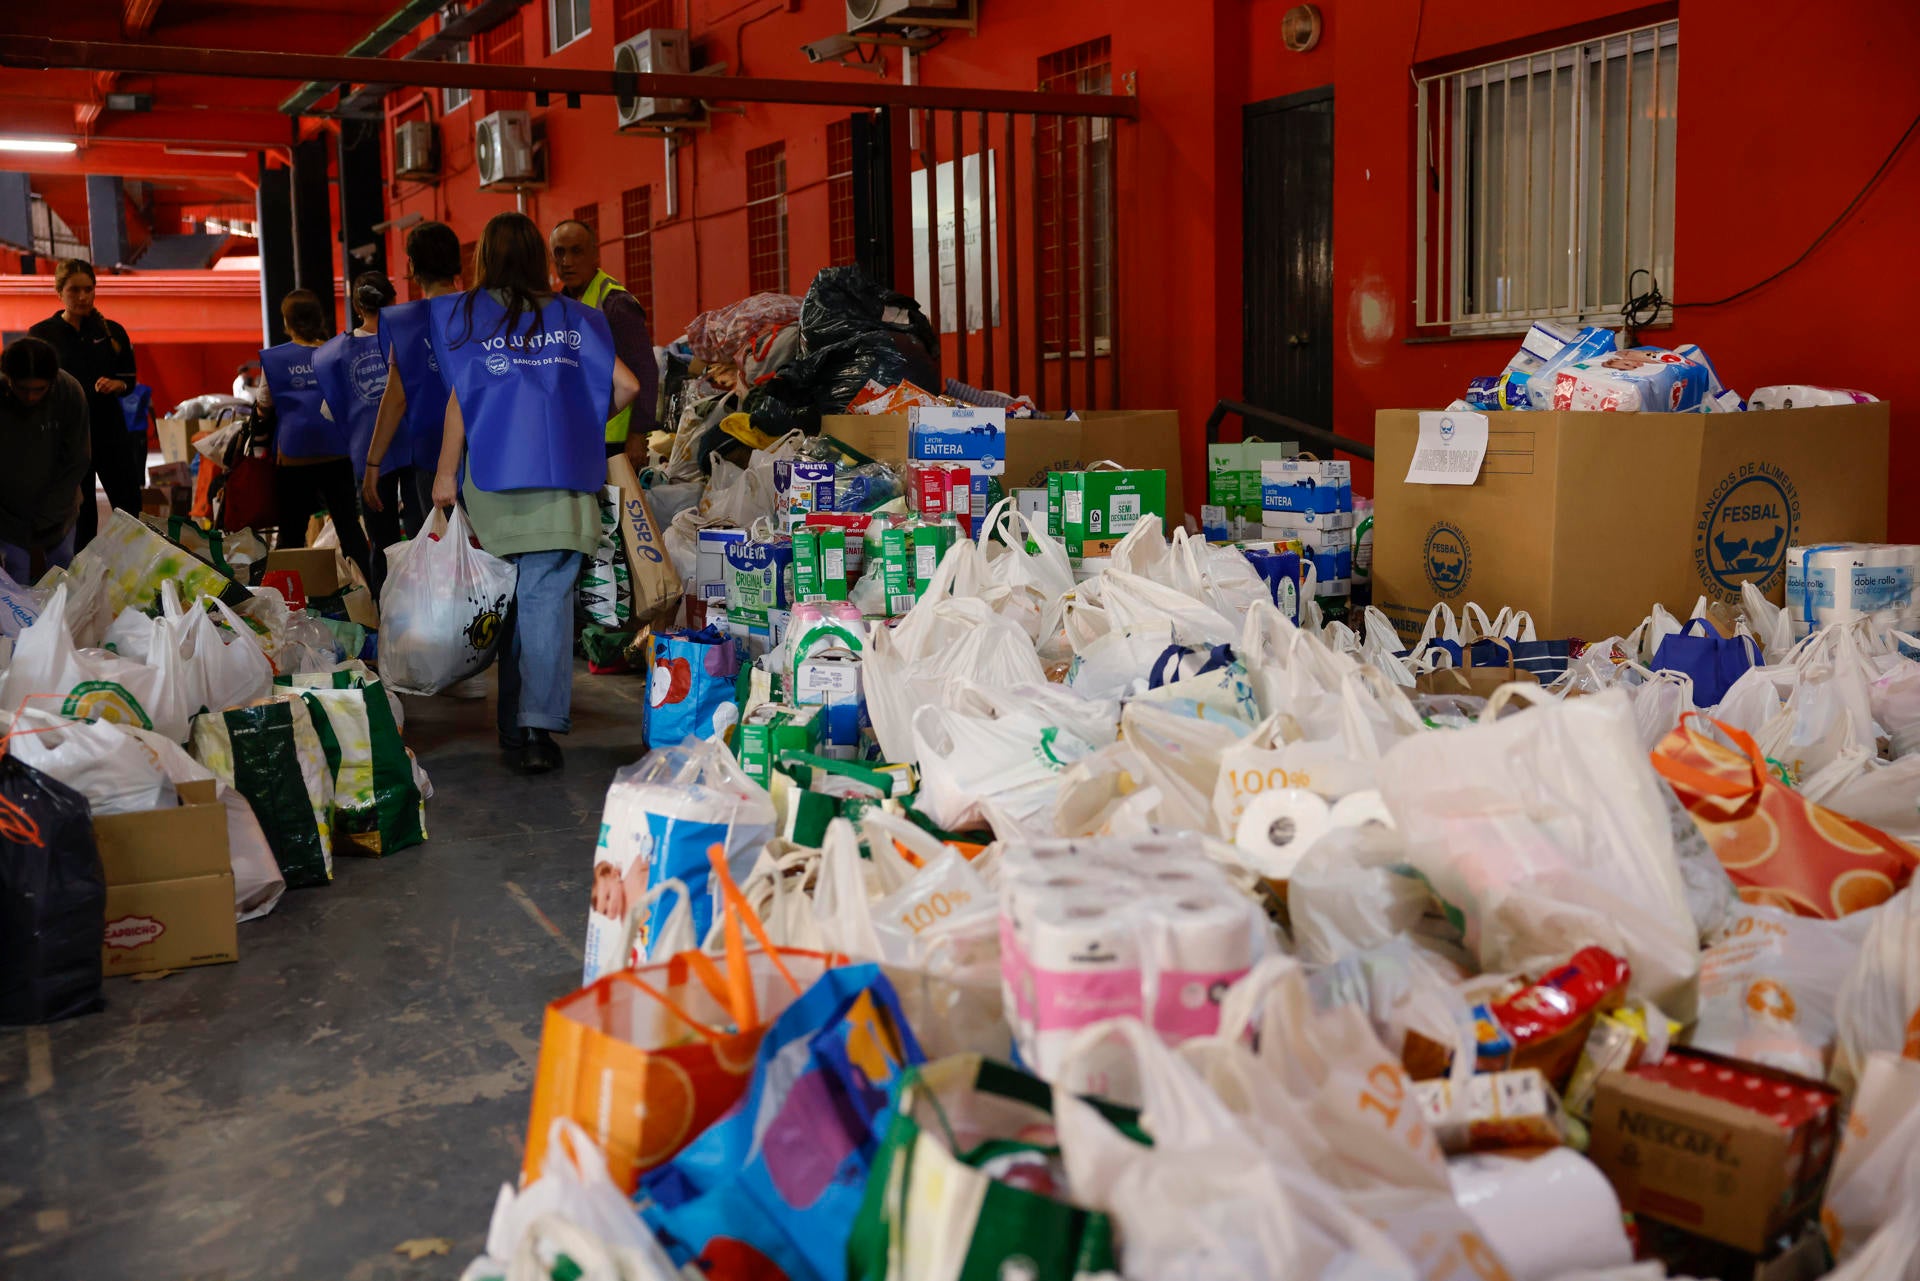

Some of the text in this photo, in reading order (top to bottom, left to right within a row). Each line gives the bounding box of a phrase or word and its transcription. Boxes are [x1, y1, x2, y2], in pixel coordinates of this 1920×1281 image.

[924, 444, 963, 455] ENTERA
[1265, 496, 1292, 507] ENTERA
[1697, 461, 1800, 531] BANCOS DE ALIMENTOS
[1118, 504, 1132, 514] SEMI
[1722, 503, 1780, 522] FESBAL
[626, 499, 653, 542] asics
[1110, 513, 1139, 522] DESNATADA
[729, 544, 767, 560] PULEVA
[1432, 543, 1460, 555] FESBAL
[735, 571, 762, 588] ORIGINAL
[1695, 548, 1724, 600] BANCOS
[1854, 575, 1896, 587] doble rollo
[1807, 580, 1824, 589] rollo
[1228, 767, 1311, 798] 100%
[902, 889, 973, 937] 100%
